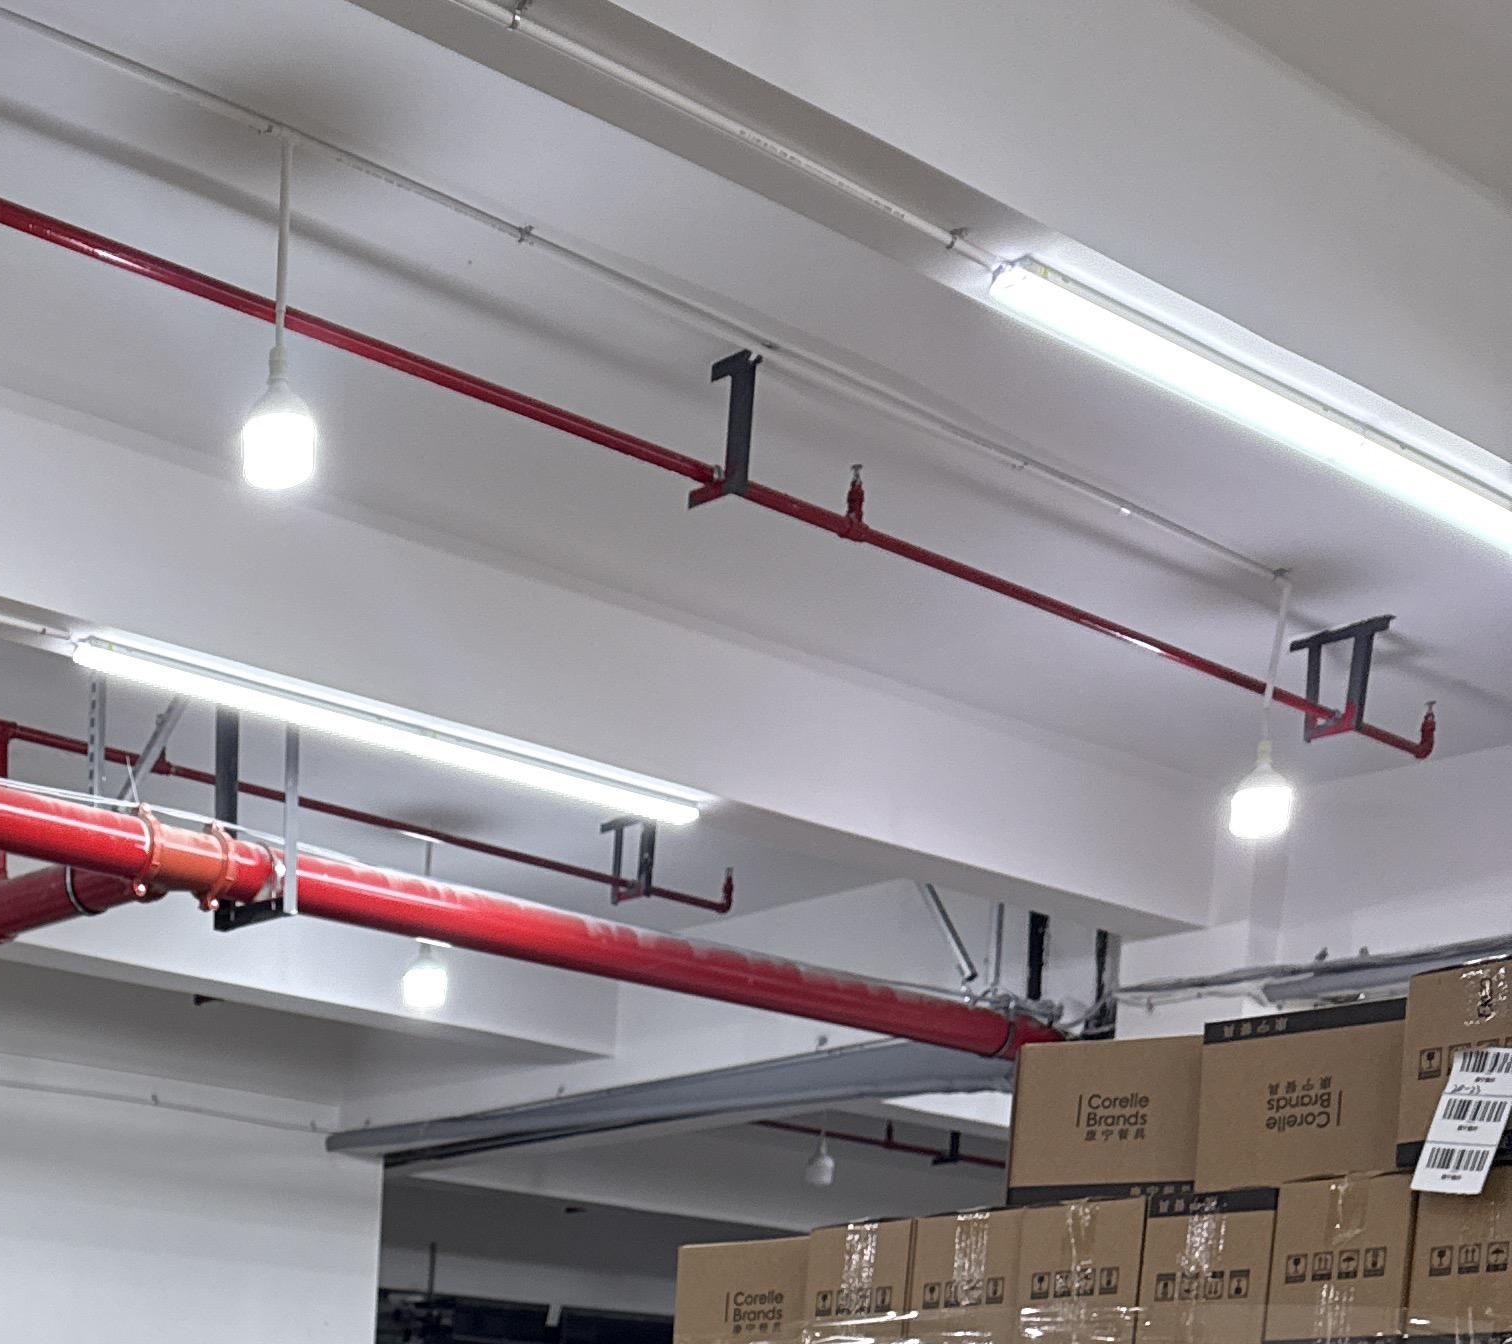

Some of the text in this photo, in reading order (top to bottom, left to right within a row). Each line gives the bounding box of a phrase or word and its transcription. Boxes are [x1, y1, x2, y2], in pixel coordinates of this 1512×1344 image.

[1088, 1093, 1150, 1110] Corelle
[1267, 1091, 1332, 1111] Brands
[1086, 1111, 1148, 1128] Brands
[1265, 1111, 1331, 1132] Corelle
[733, 1291, 784, 1307] Corelle
[732, 1306, 783, 1322] Brands
